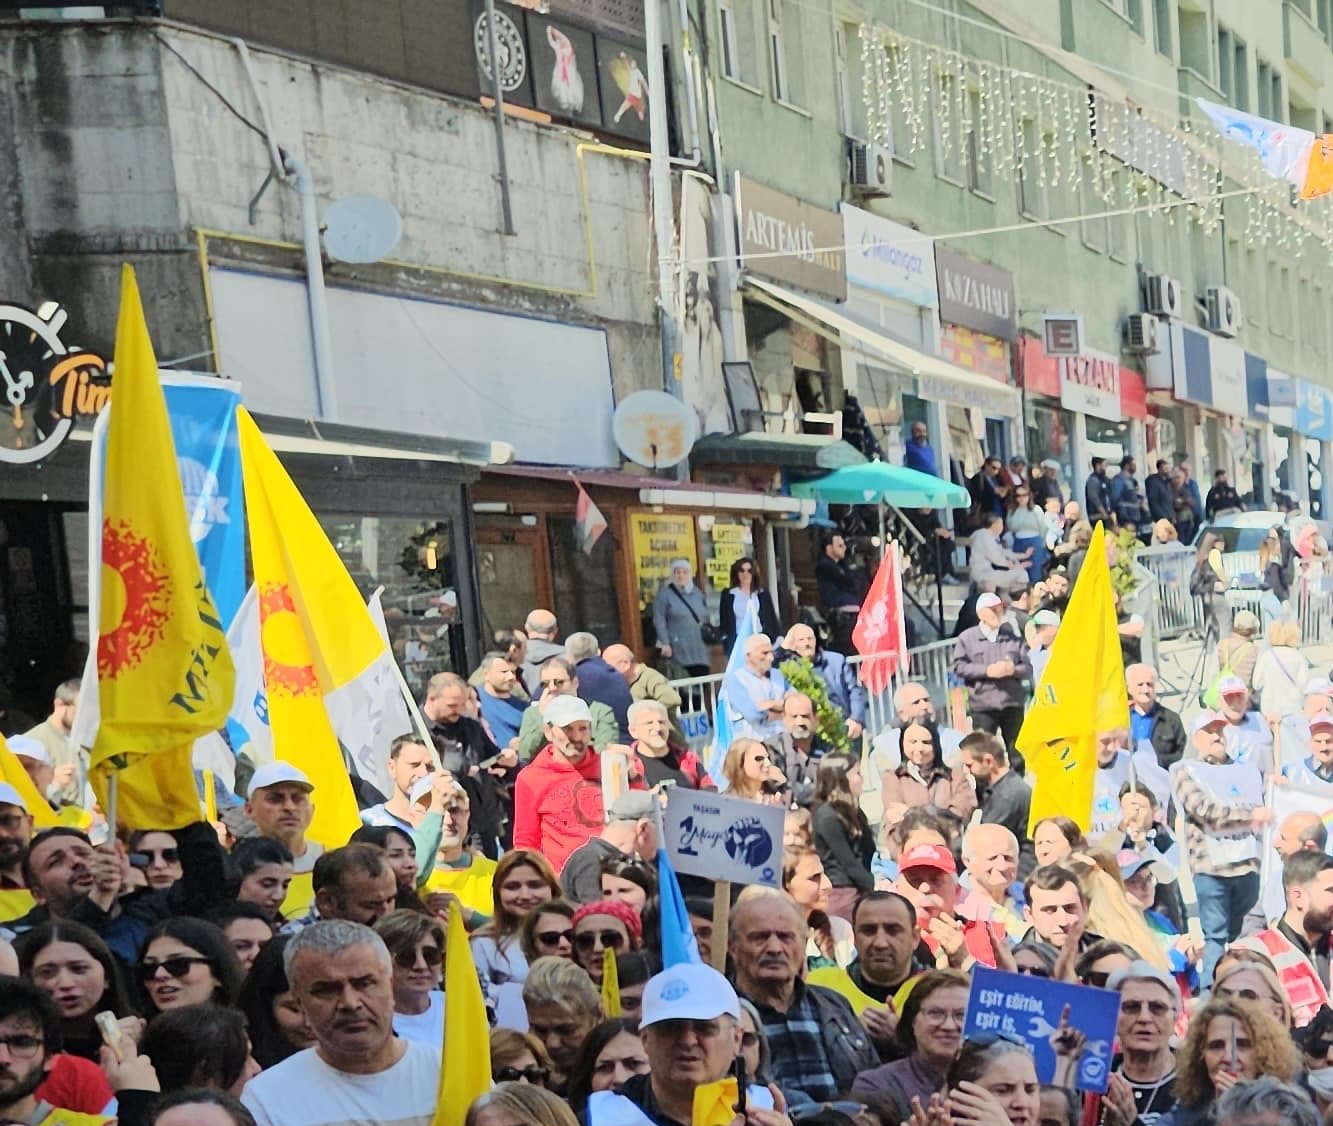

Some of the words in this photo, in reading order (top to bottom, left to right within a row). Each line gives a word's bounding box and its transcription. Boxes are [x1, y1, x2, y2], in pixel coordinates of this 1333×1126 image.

[746, 208, 815, 263] ARTEMİS
[872, 234, 923, 281] Milangaz
[50, 354, 114, 417] Tim
[979, 989, 1005, 1009] EŞİT
